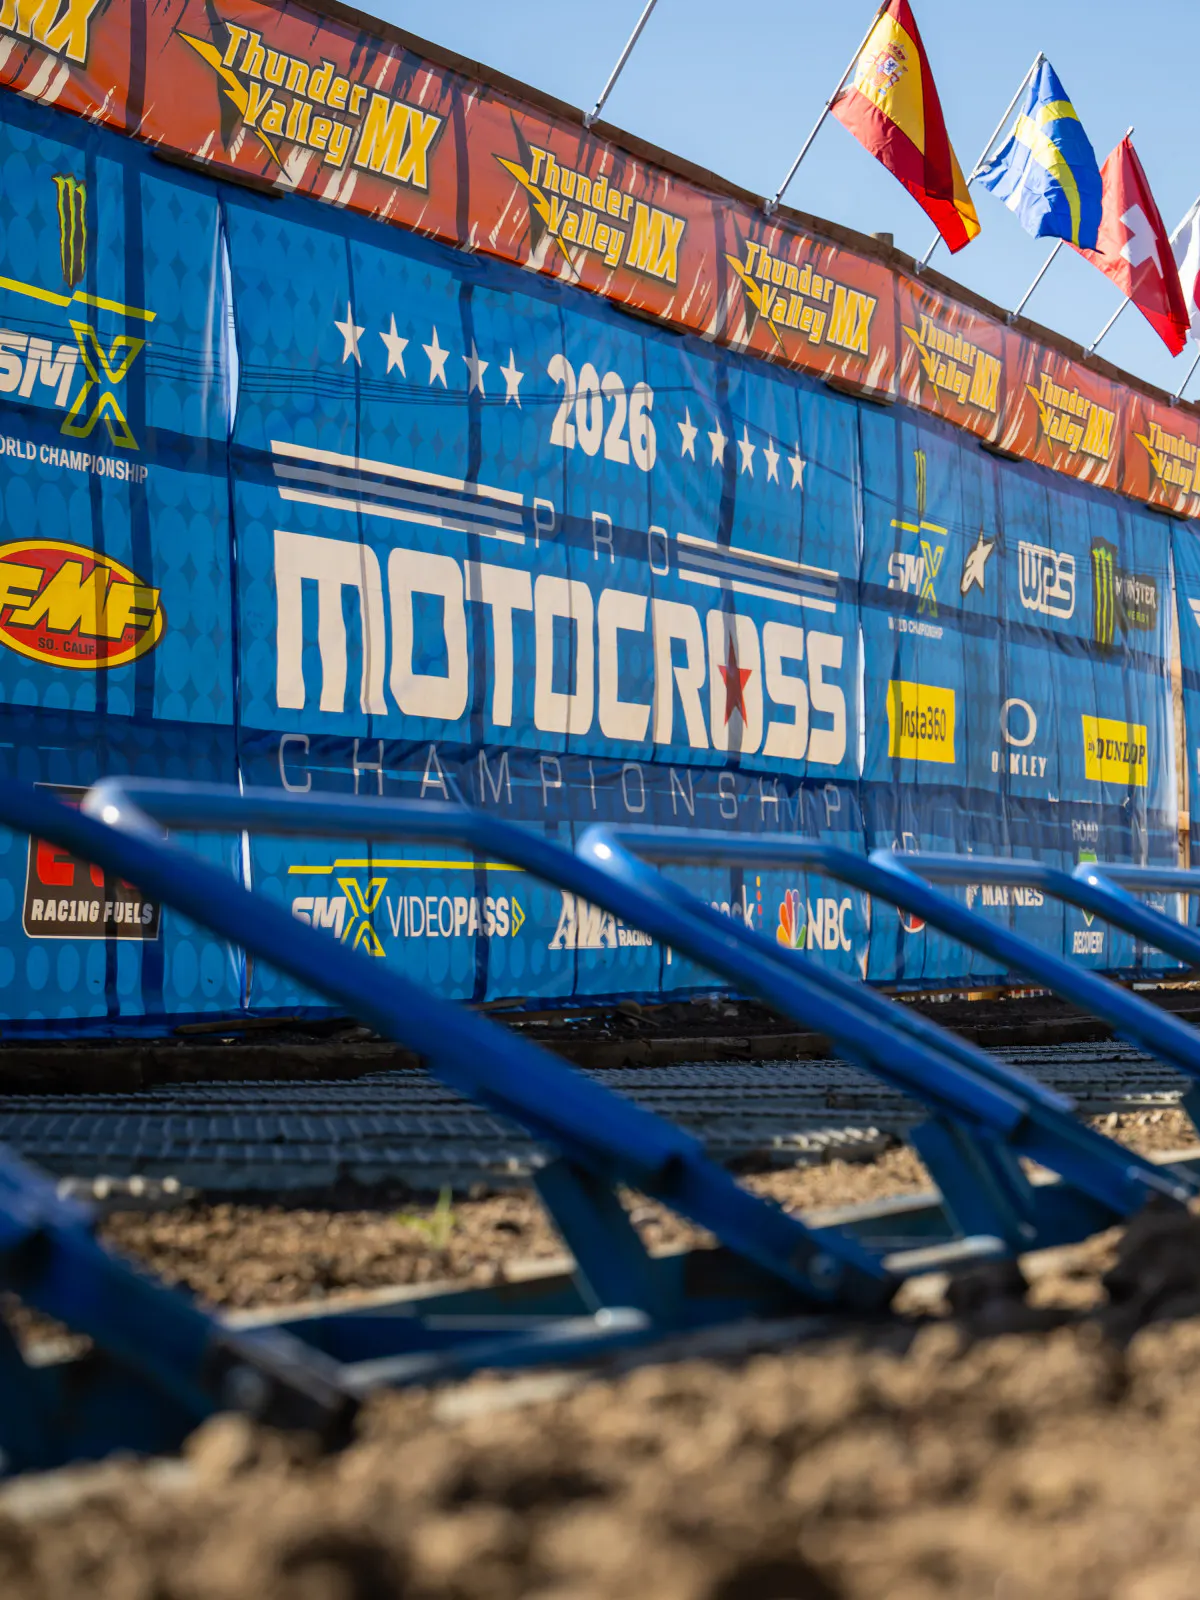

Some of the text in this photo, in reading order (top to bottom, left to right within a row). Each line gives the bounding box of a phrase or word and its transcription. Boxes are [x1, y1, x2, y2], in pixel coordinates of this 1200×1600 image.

[222, 20, 366, 117] Thunder
[242, 82, 444, 189] Valley MX
[529, 143, 634, 222] Thunder
[547, 195, 688, 285] Valley MX
[744, 239, 835, 304] Thunder
[760, 284, 878, 356] Valley MX
[919, 313, 977, 367] Thunder
[928, 350, 1002, 414] Valley MX
[1039, 372, 1091, 420] Thunder
[547, 353, 656, 472] 2026
[1044, 403, 1116, 461] Valley MX
[0, 435, 148, 484] ORLD CHAMPIONSHIP
[1149, 421, 1197, 464] Thunder
[1157, 451, 1193, 495] Valley
[531, 496, 670, 577] PRO
[0, 558, 161, 643] FMF
[888, 540, 944, 618] SMX
[1018, 540, 1076, 619] WPS
[38, 637, 99, 657] SO. CALIF.
[273, 530, 847, 766] MOTOCROSS
[888, 616, 907, 633] WLD
[900, 701, 946, 742] Insta360
[1096, 738, 1146, 765] DUNLOP
[279, 733, 841, 827] CHAMPIONSHIP
[1072, 819, 1099, 842] ROAD
[104, 901, 153, 925] FUELS
[386, 896, 510, 938] VIDEOPASS
[982, 884, 1044, 907] MANES
[618, 929, 652, 947] RACING
[807, 897, 852, 952] NBC
